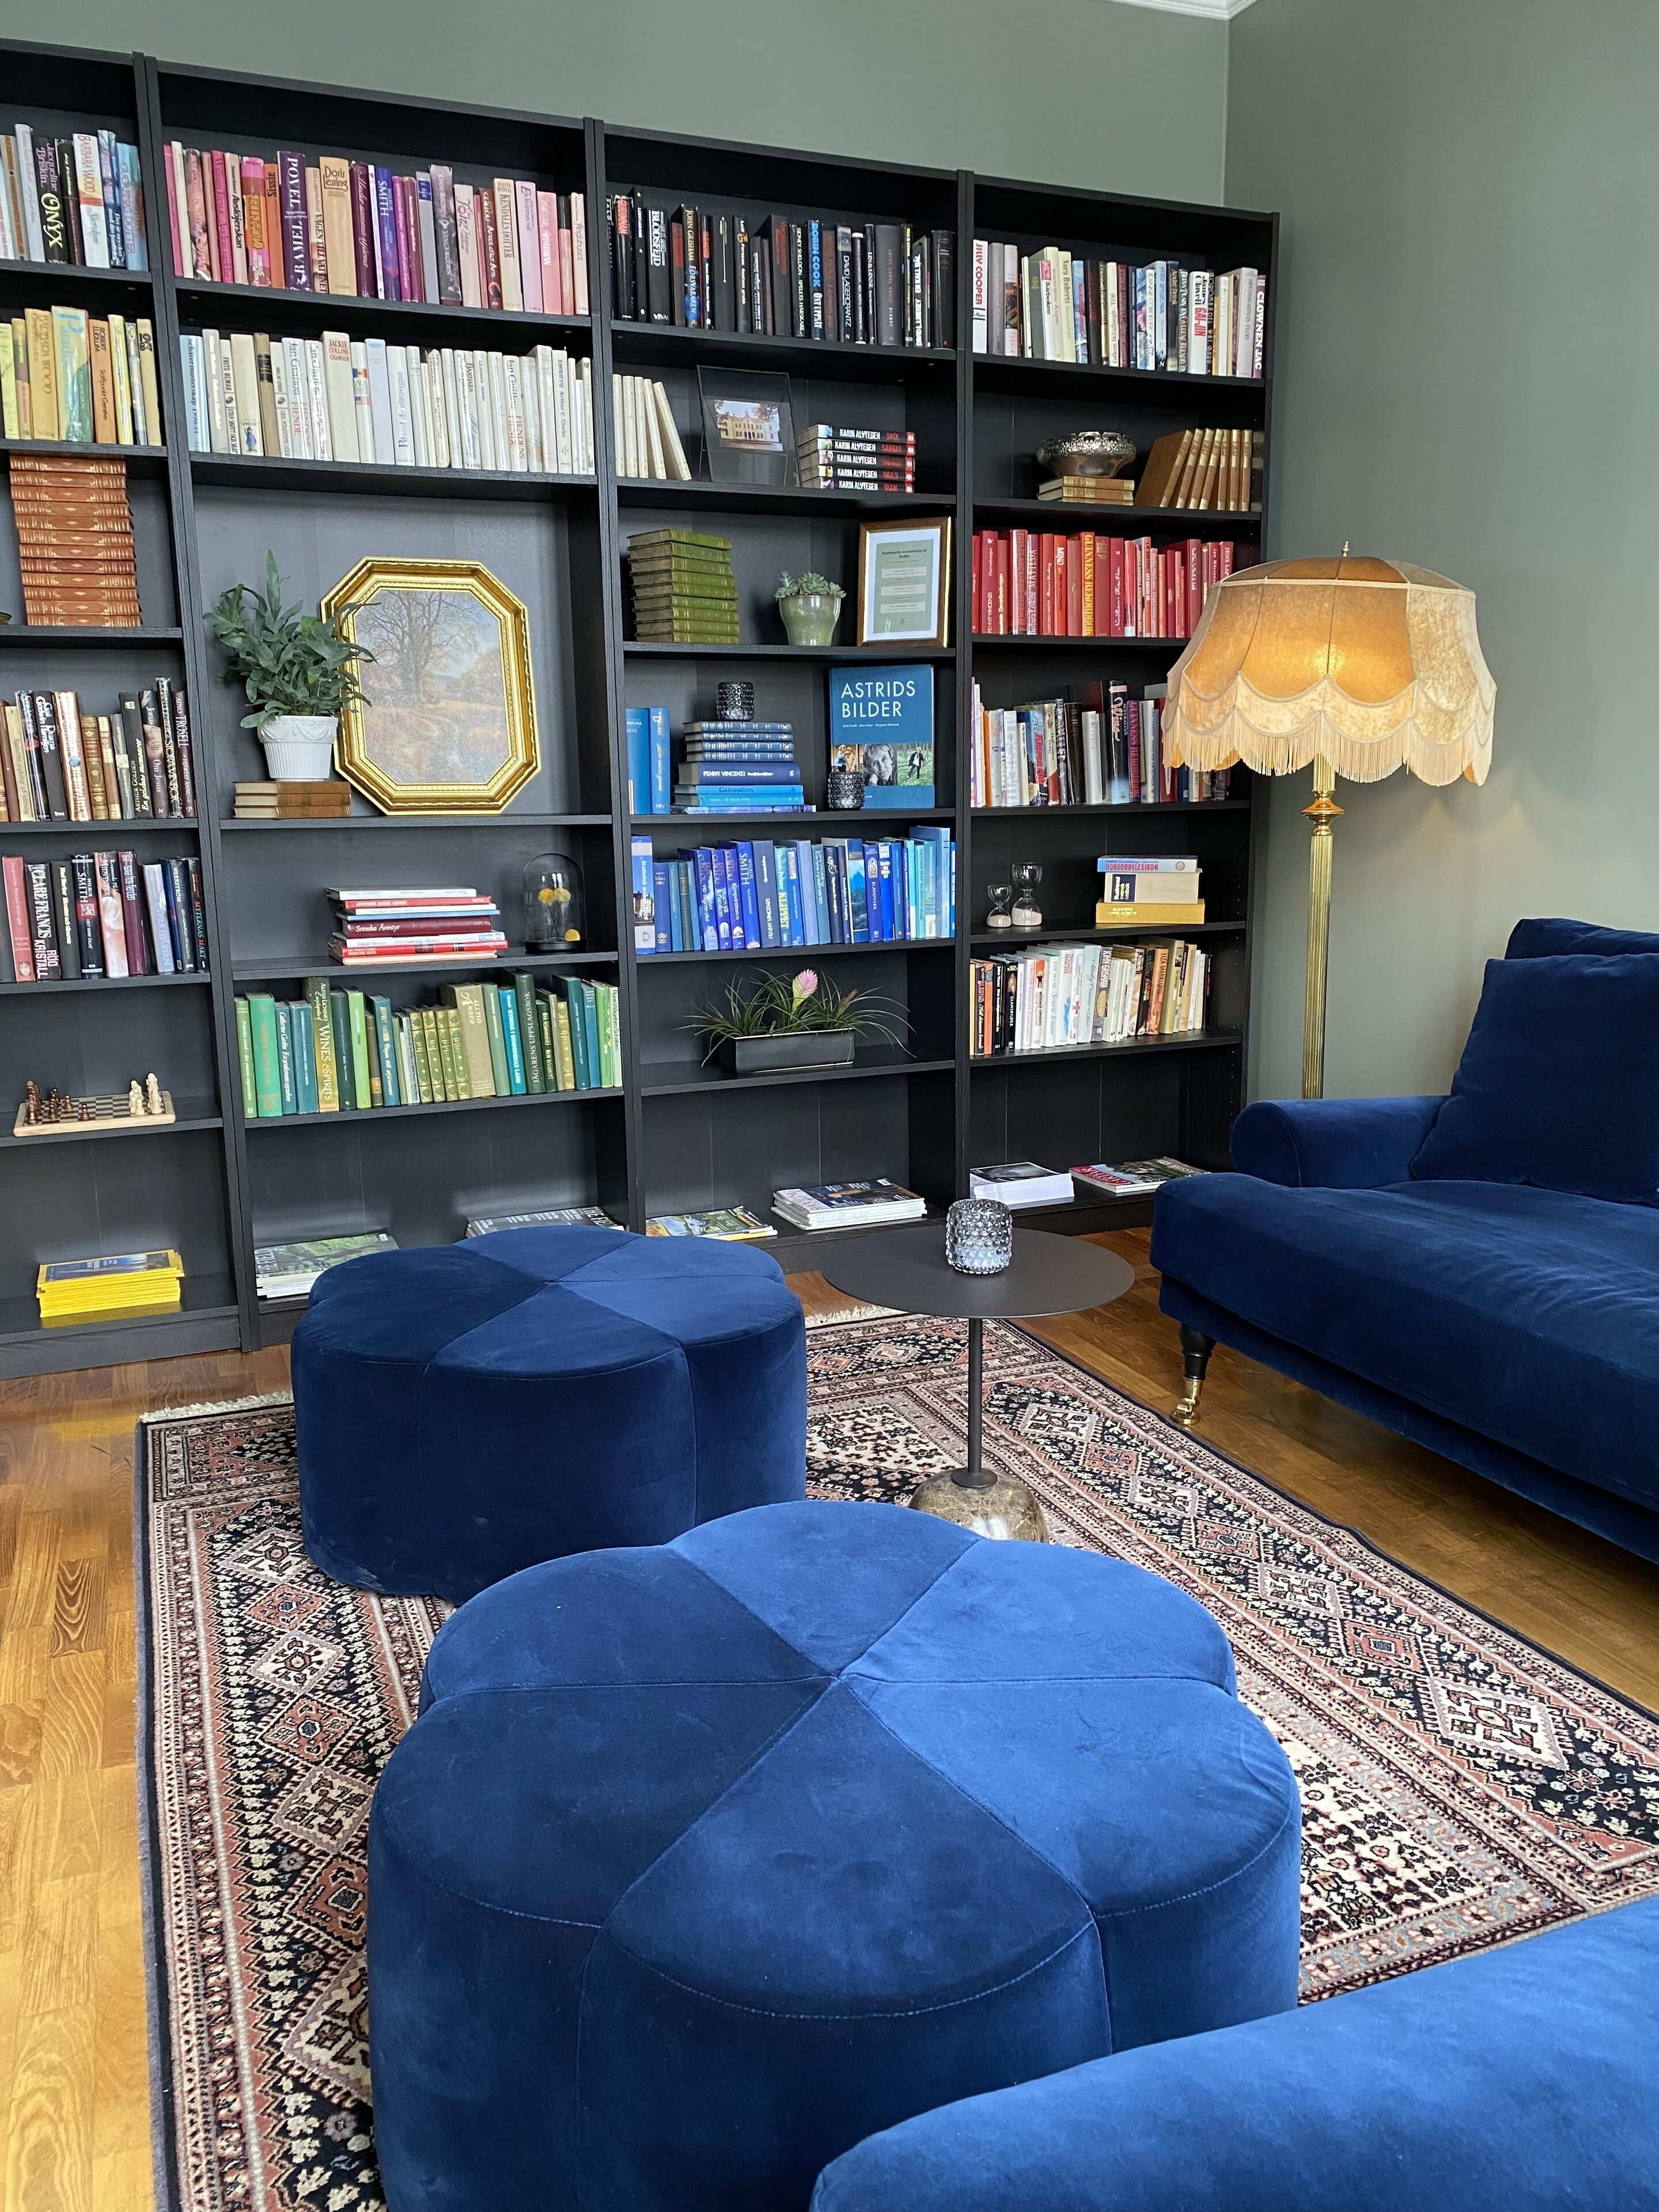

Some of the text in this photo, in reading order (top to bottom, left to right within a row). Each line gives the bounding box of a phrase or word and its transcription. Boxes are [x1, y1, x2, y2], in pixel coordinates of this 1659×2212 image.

[36, 147, 47, 188] Briskin
[46, 143, 58, 191] Jacqueline
[77, 135, 95, 192] BARBARA WOOD
[324, 165, 345, 178] Doris
[266, 172, 277, 197] Sissie
[358, 177, 367, 204] Under
[378, 180, 389, 216] SMITH
[40, 192, 63, 248] ONYX
[249, 193, 264, 250] GIGANTEN
[287, 157, 305, 274] POVEL RAMEL
[499, 194, 513, 258] KENDALLS DOTTER
[685, 210, 694, 228] JOHN
[358, 236, 369, 267] stjärna
[652, 210, 661, 267] BLODSFEJD
[687, 230, 695, 261] GRISHAM
[810, 222, 819, 255] ROBIN
[812, 256, 821, 287] COOK
[843, 276, 851, 327] LAGERCRANTZ
[1195, 275, 1203, 305] Clavell
[1195, 307, 1206, 336] GAI-JIN
[1256, 291, 1264, 348] CLOWNEN
[288, 341, 297, 357] Jan
[329, 339, 347, 349] JACKIE
[43, 359, 51, 394] WOOD
[466, 363, 474, 392] BARBARA
[291, 402, 301, 435] FIENDE
[516, 415, 525, 459] FIENDENS
[835, 441, 850, 450] KARIN
[851, 442, 876, 452] ALVTEGEN
[839, 429, 880, 440] KARIN ALVTEGEN
[836, 454, 877, 465] KARIN ALVTEGEN
[839, 480, 853, 489] KARIN
[854, 482, 878, 491] ALVTEGEN
[1083, 534, 1093, 579] GUINNESS
[1028, 549, 1036, 635] Barbara Erskine MATILDA
[841, 680, 915, 698] ASTRIDS
[43, 702, 52, 717] Gail
[146, 706, 154, 725] Jonas
[842, 701, 902, 718] BILDER
[1129, 702, 1139, 745] GUINNESS
[46, 725, 55, 750] Drama
[175, 715, 188, 748] TROSELL
[152, 759, 161, 772] Om
[154, 774, 163, 793] Jesus
[739, 853, 749, 885] SMITH
[78, 872, 88, 903] SMITH
[32, 869, 52, 938] CLARE FRANCIS
[778, 892, 789, 929] KLIPPET
[194, 901, 206, 959] MYTERNAS MAKT
[355, 923, 401, 933] Svenska Äventyr
[34, 939, 48, 979] KRISTALL
[1100, 950, 1112, 988] JOHN GRISHAM
[1157, 965, 1166, 994] MARKLUND
[460, 991, 475, 1025] AMBER
[474, 998, 482, 1024] ALLTID
[507, 1009, 515, 1031] KVINNA
[524, 991, 540, 1083] JÄGARENS UPPSLAGSBOK
